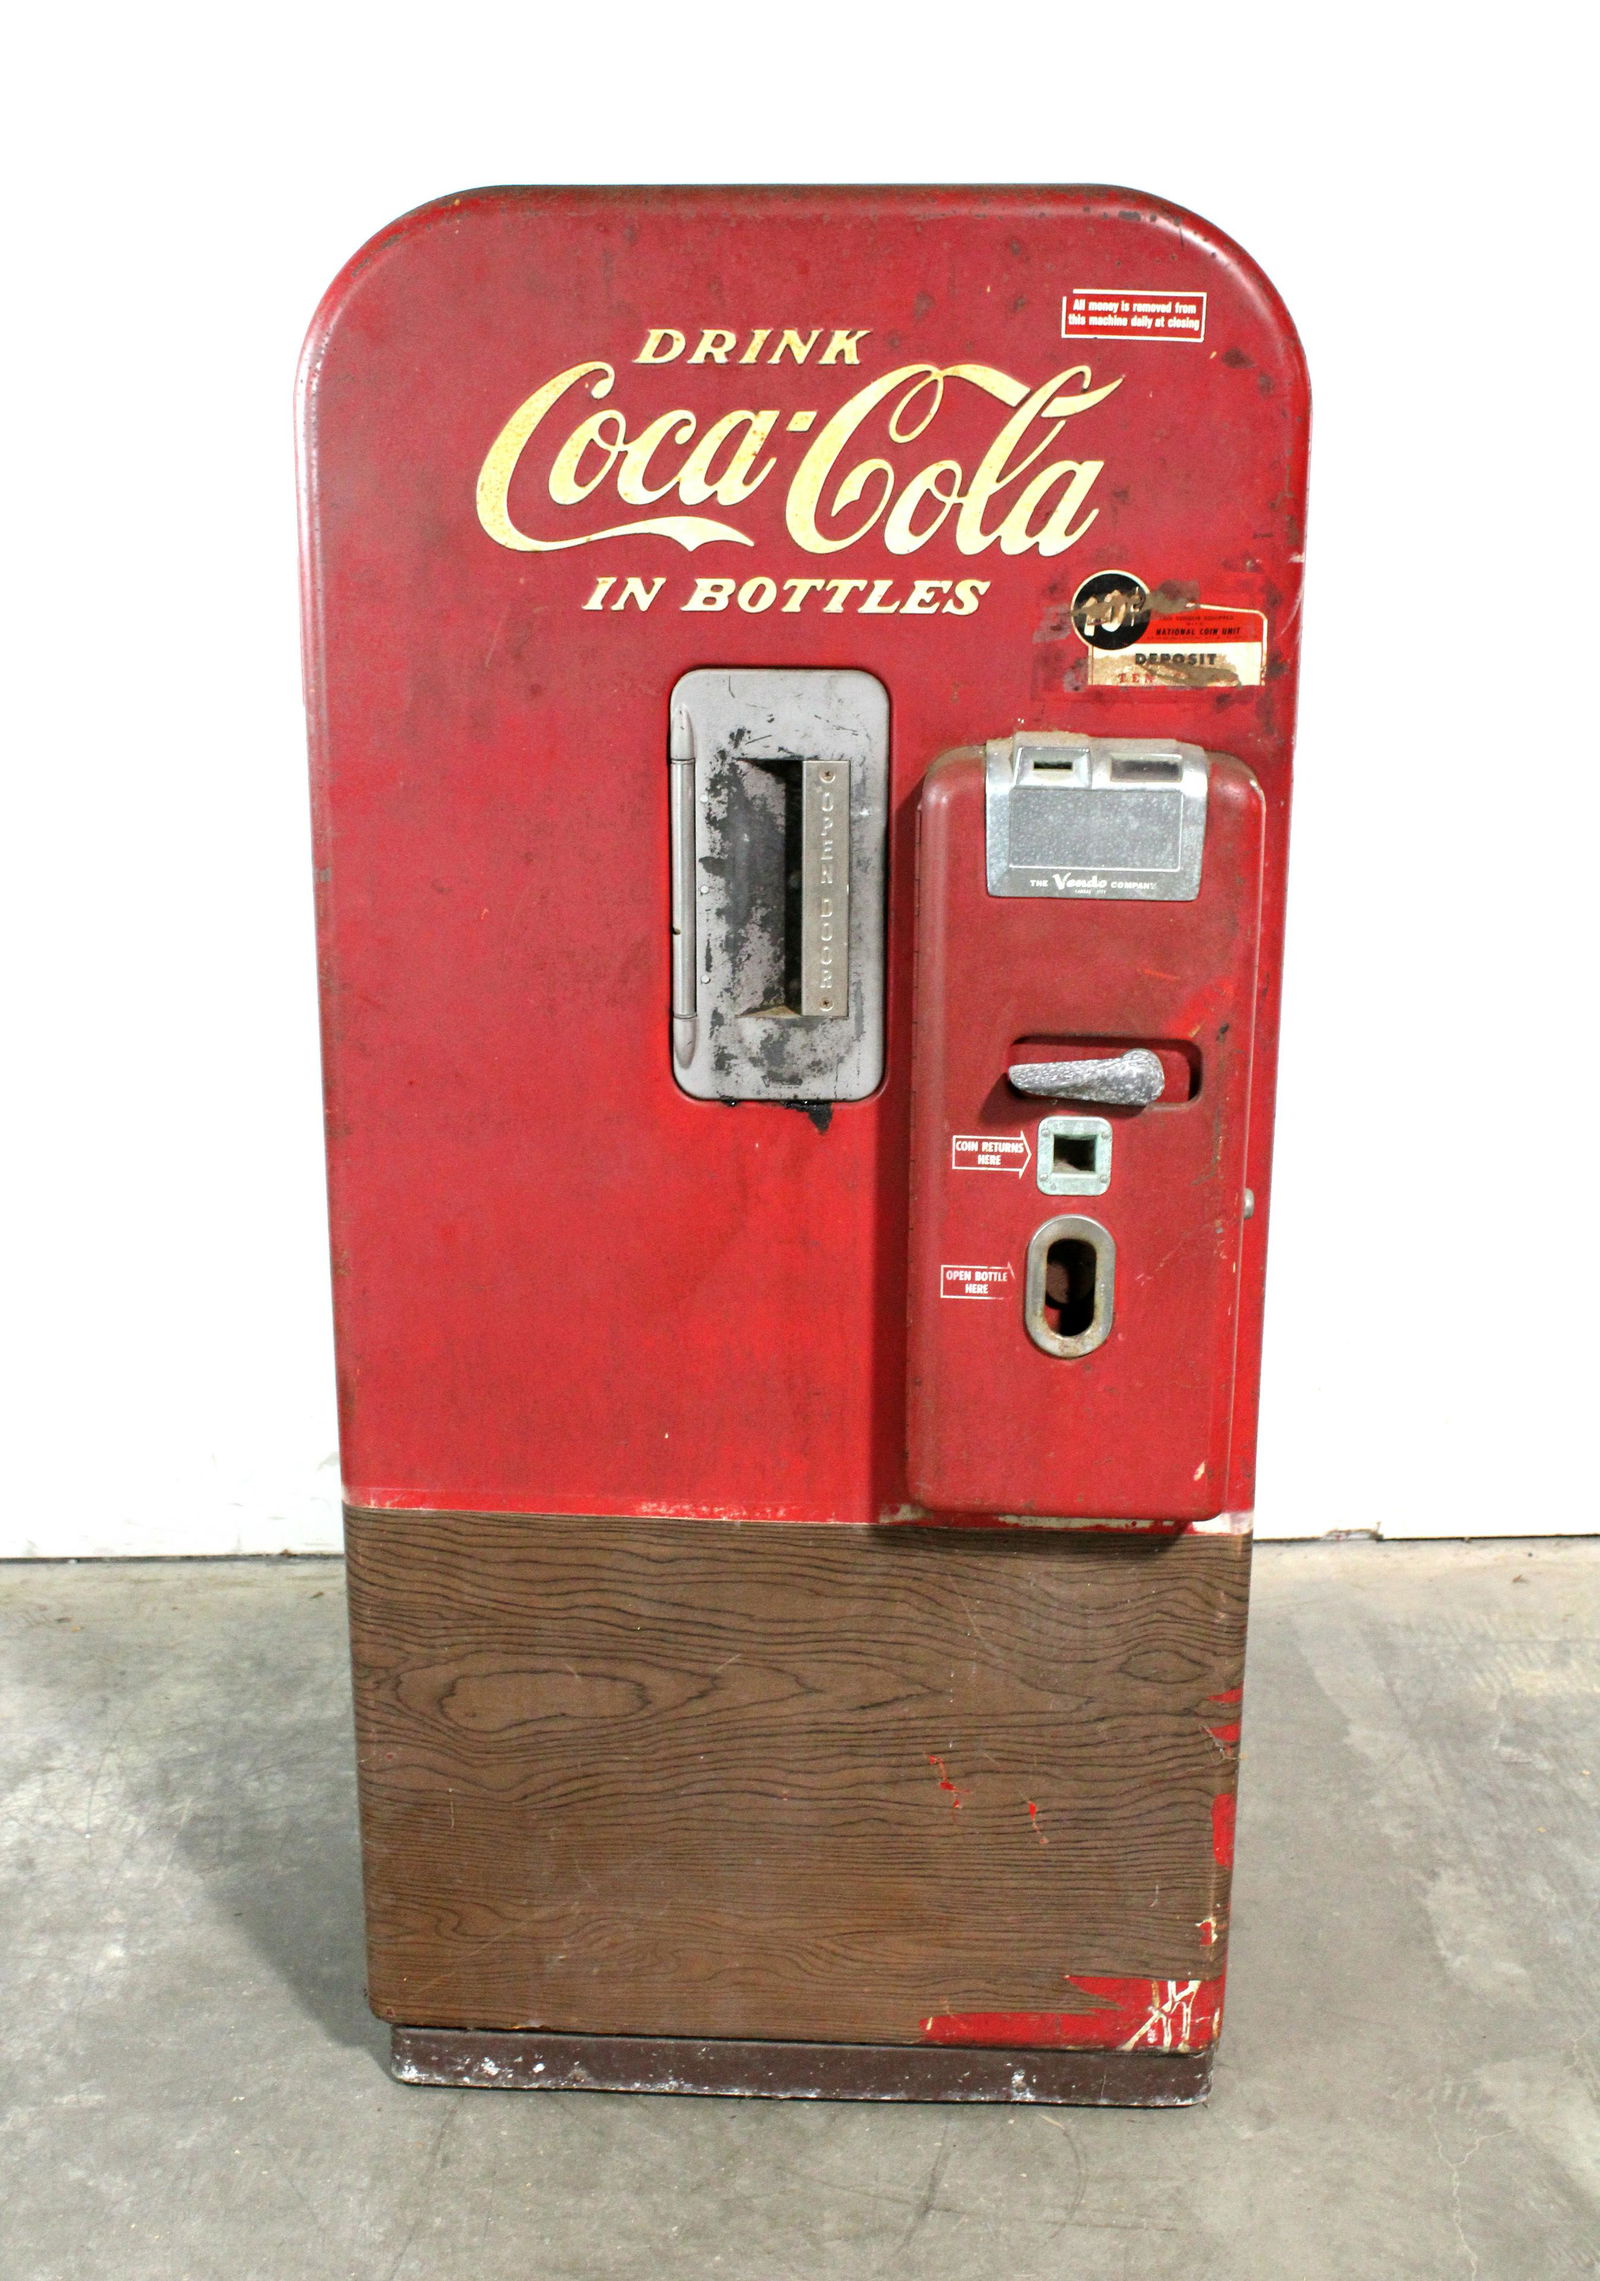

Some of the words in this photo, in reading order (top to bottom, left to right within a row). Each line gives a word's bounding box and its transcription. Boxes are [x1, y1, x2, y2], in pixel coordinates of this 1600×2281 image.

[1072, 299, 1086, 311] All
[1088, 301, 1119, 313] money
[1121, 301, 1130, 312] is
[1132, 302, 1172, 313] removed
[1174, 302, 1197, 314] from
[1068, 313, 1086, 326] this
[1088, 314, 1128, 327] machine
[1130, 315, 1153, 329] daily
[1155, 317, 1165, 328] at
[1167, 317, 1200, 331] closing
[634, 328, 870, 365] DRINK
[581, 576, 666, 612] IN
[680, 576, 991, 616] BOTTLES
[1156, 628, 1196, 636] NATIONAL
[1222, 627, 1241, 636] UNIT
[1135, 653, 1217, 666] DEPOSIT
[820, 792, 834, 883] OPEN
[1052, 872, 1107, 890] Vendo
[820, 900, 833, 988] DOOR
[956, 1141, 978, 1152] COIN
[982, 1142, 1024, 1153] RETURNS
[978, 1155, 1001, 1165] HERE
[946, 1271, 971, 1281] OPEN
[975, 1272, 1007, 1282] BOTTLE
[965, 1284, 988, 1294] HERE
